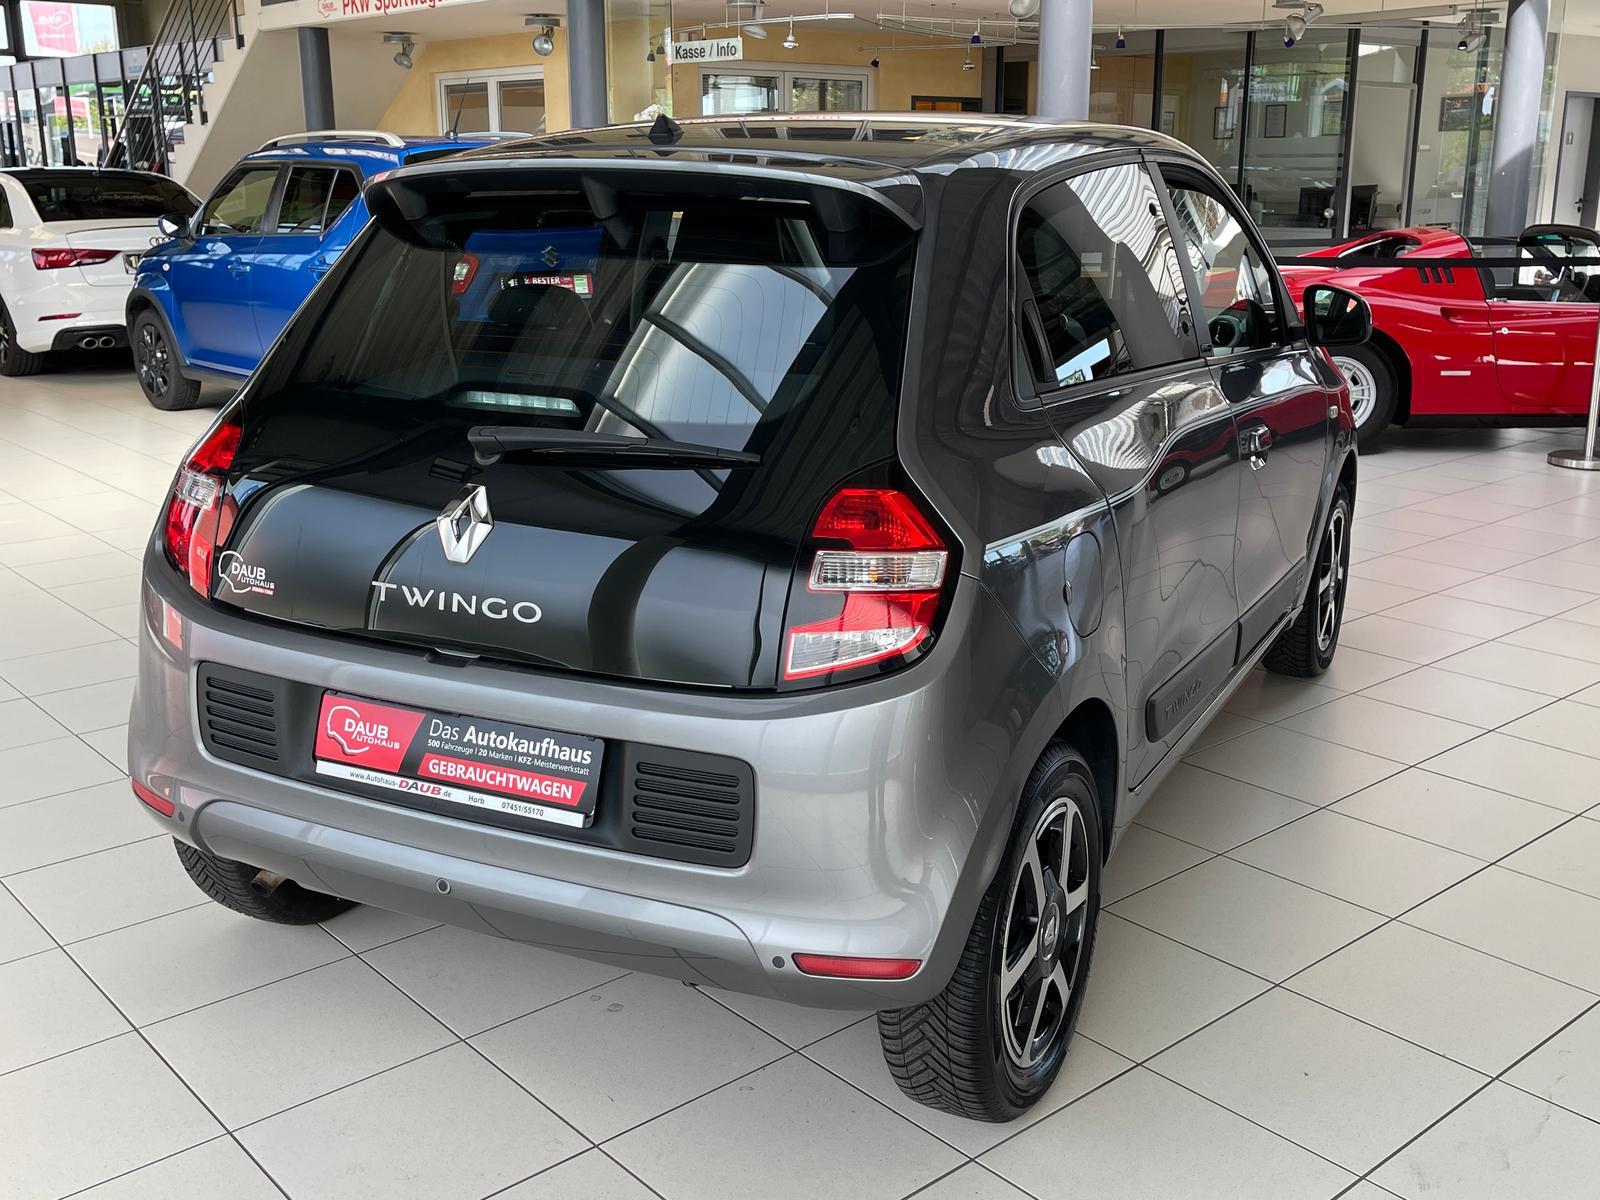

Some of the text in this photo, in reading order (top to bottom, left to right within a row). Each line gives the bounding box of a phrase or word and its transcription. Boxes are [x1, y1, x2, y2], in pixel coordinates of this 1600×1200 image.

[343, 0, 370, 15] PKW
[675, 45, 706, 60] Kasse
[716, 42, 737, 57] Info
[231, 561, 266, 581] DAUB
[372, 581, 542, 624] TWINGO
[344, 718, 389, 740] DAUB
[429, 718, 592, 765] Das Autokaufhaus
[427, 738, 441, 748] 500
[441, 741, 474, 756] Fahrzeuge
[478, 748, 488, 757] 20
[489, 750, 513, 761] Marken
[518, 755, 590, 776] KFZ-Meisterwerkstatt
[428, 759, 573, 799] GEBRAUCHTWAGEN
[468, 795, 485, 805] Horb
[501, 802, 544, 817] 07451/55170
